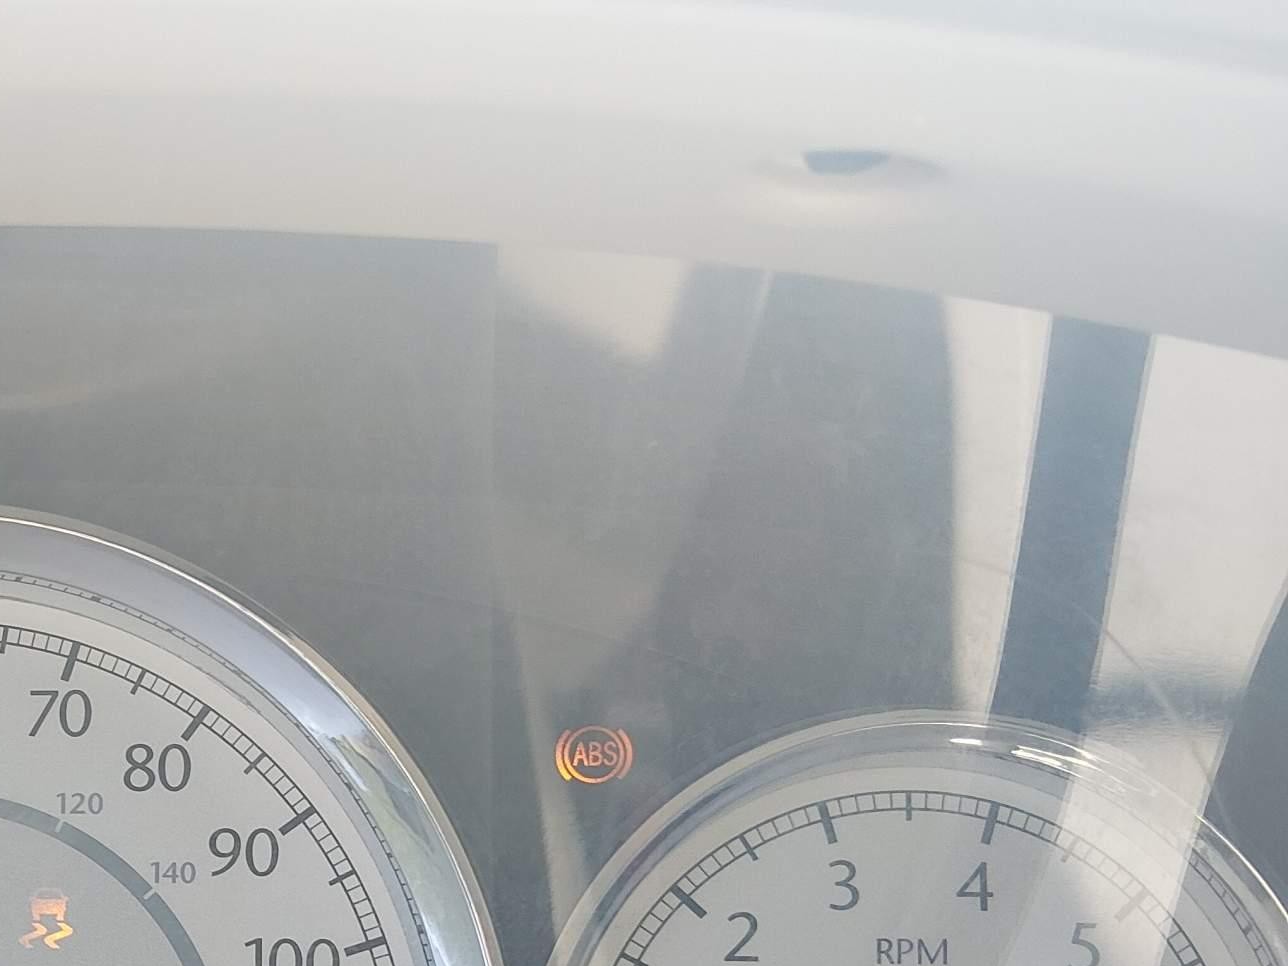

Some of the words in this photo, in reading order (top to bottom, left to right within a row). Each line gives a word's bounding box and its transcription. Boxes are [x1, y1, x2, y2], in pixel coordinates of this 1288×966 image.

[29, 690, 92, 737] 70
[123, 744, 192, 791] 80
[572, 741, 617, 767] ABS
[56, 793, 103, 815] 120
[150, 862, 196, 885] 140
[209, 828, 279, 877] 90
[829, 860, 861, 911] 3
[956, 862, 994, 911] 4
[723, 912, 759, 962] 2
[876, 938, 949, 965] RPM
